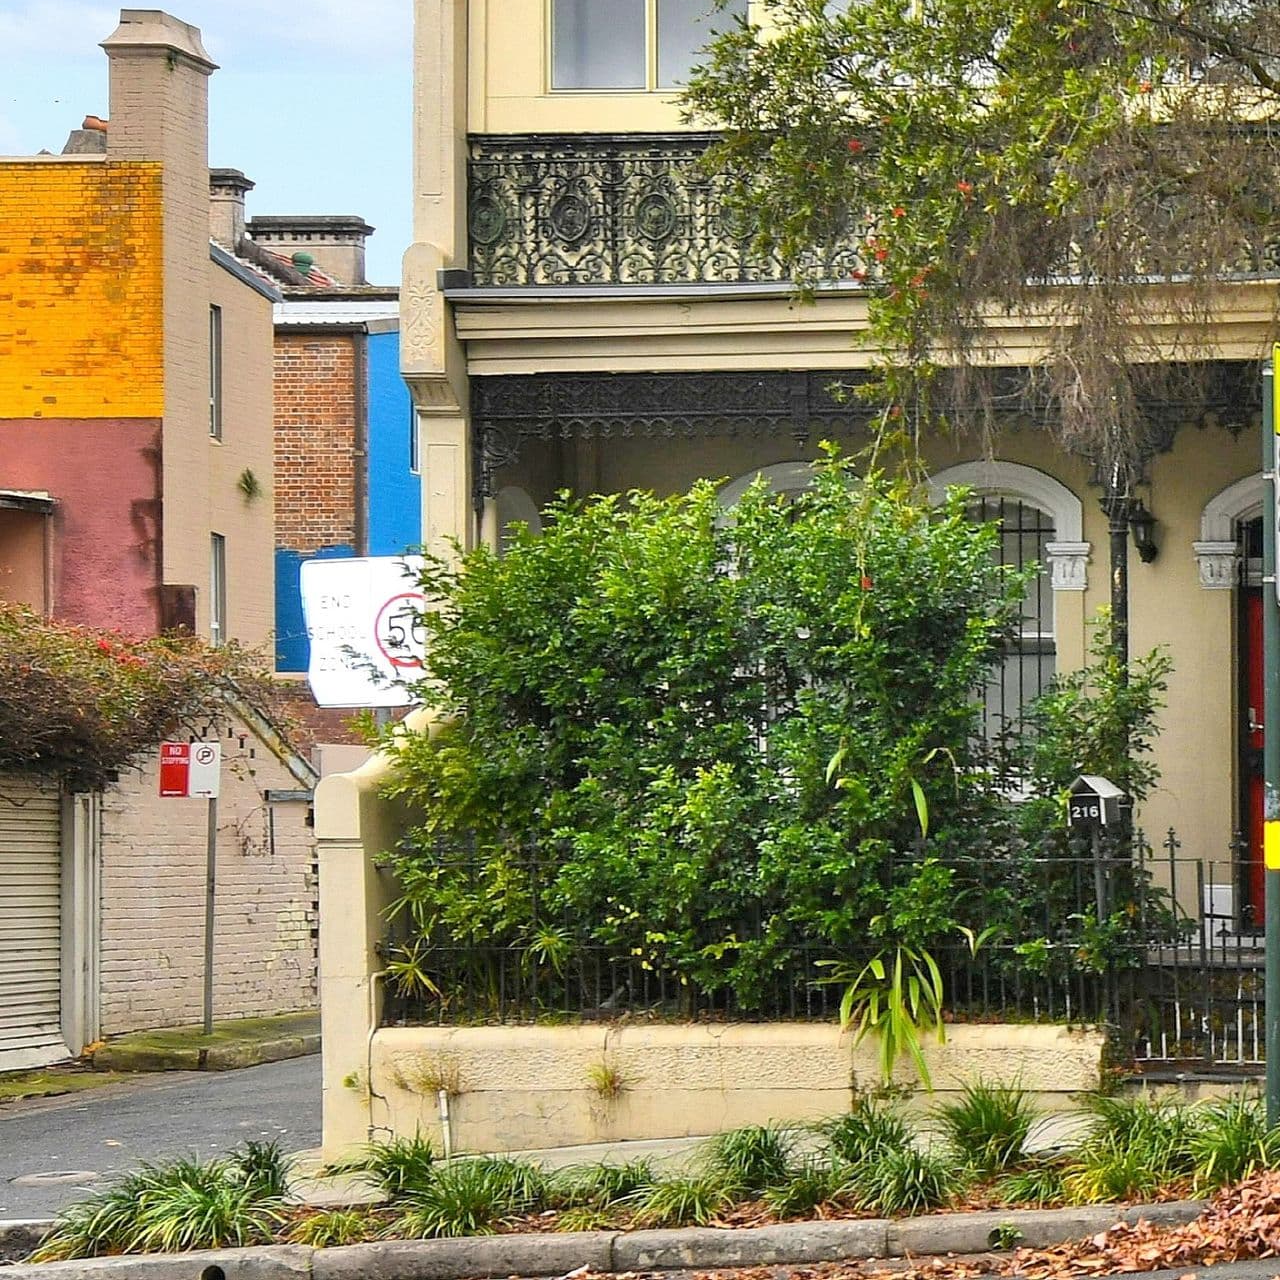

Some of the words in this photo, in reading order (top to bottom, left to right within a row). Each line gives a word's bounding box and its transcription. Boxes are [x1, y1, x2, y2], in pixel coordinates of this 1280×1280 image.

[321, 595, 352, 609] END
[308, 625, 367, 641] SCHOOL
[320, 656, 353, 672] ZON
[169, 747, 182, 756] NO
[1072, 806, 1099, 818] 216
